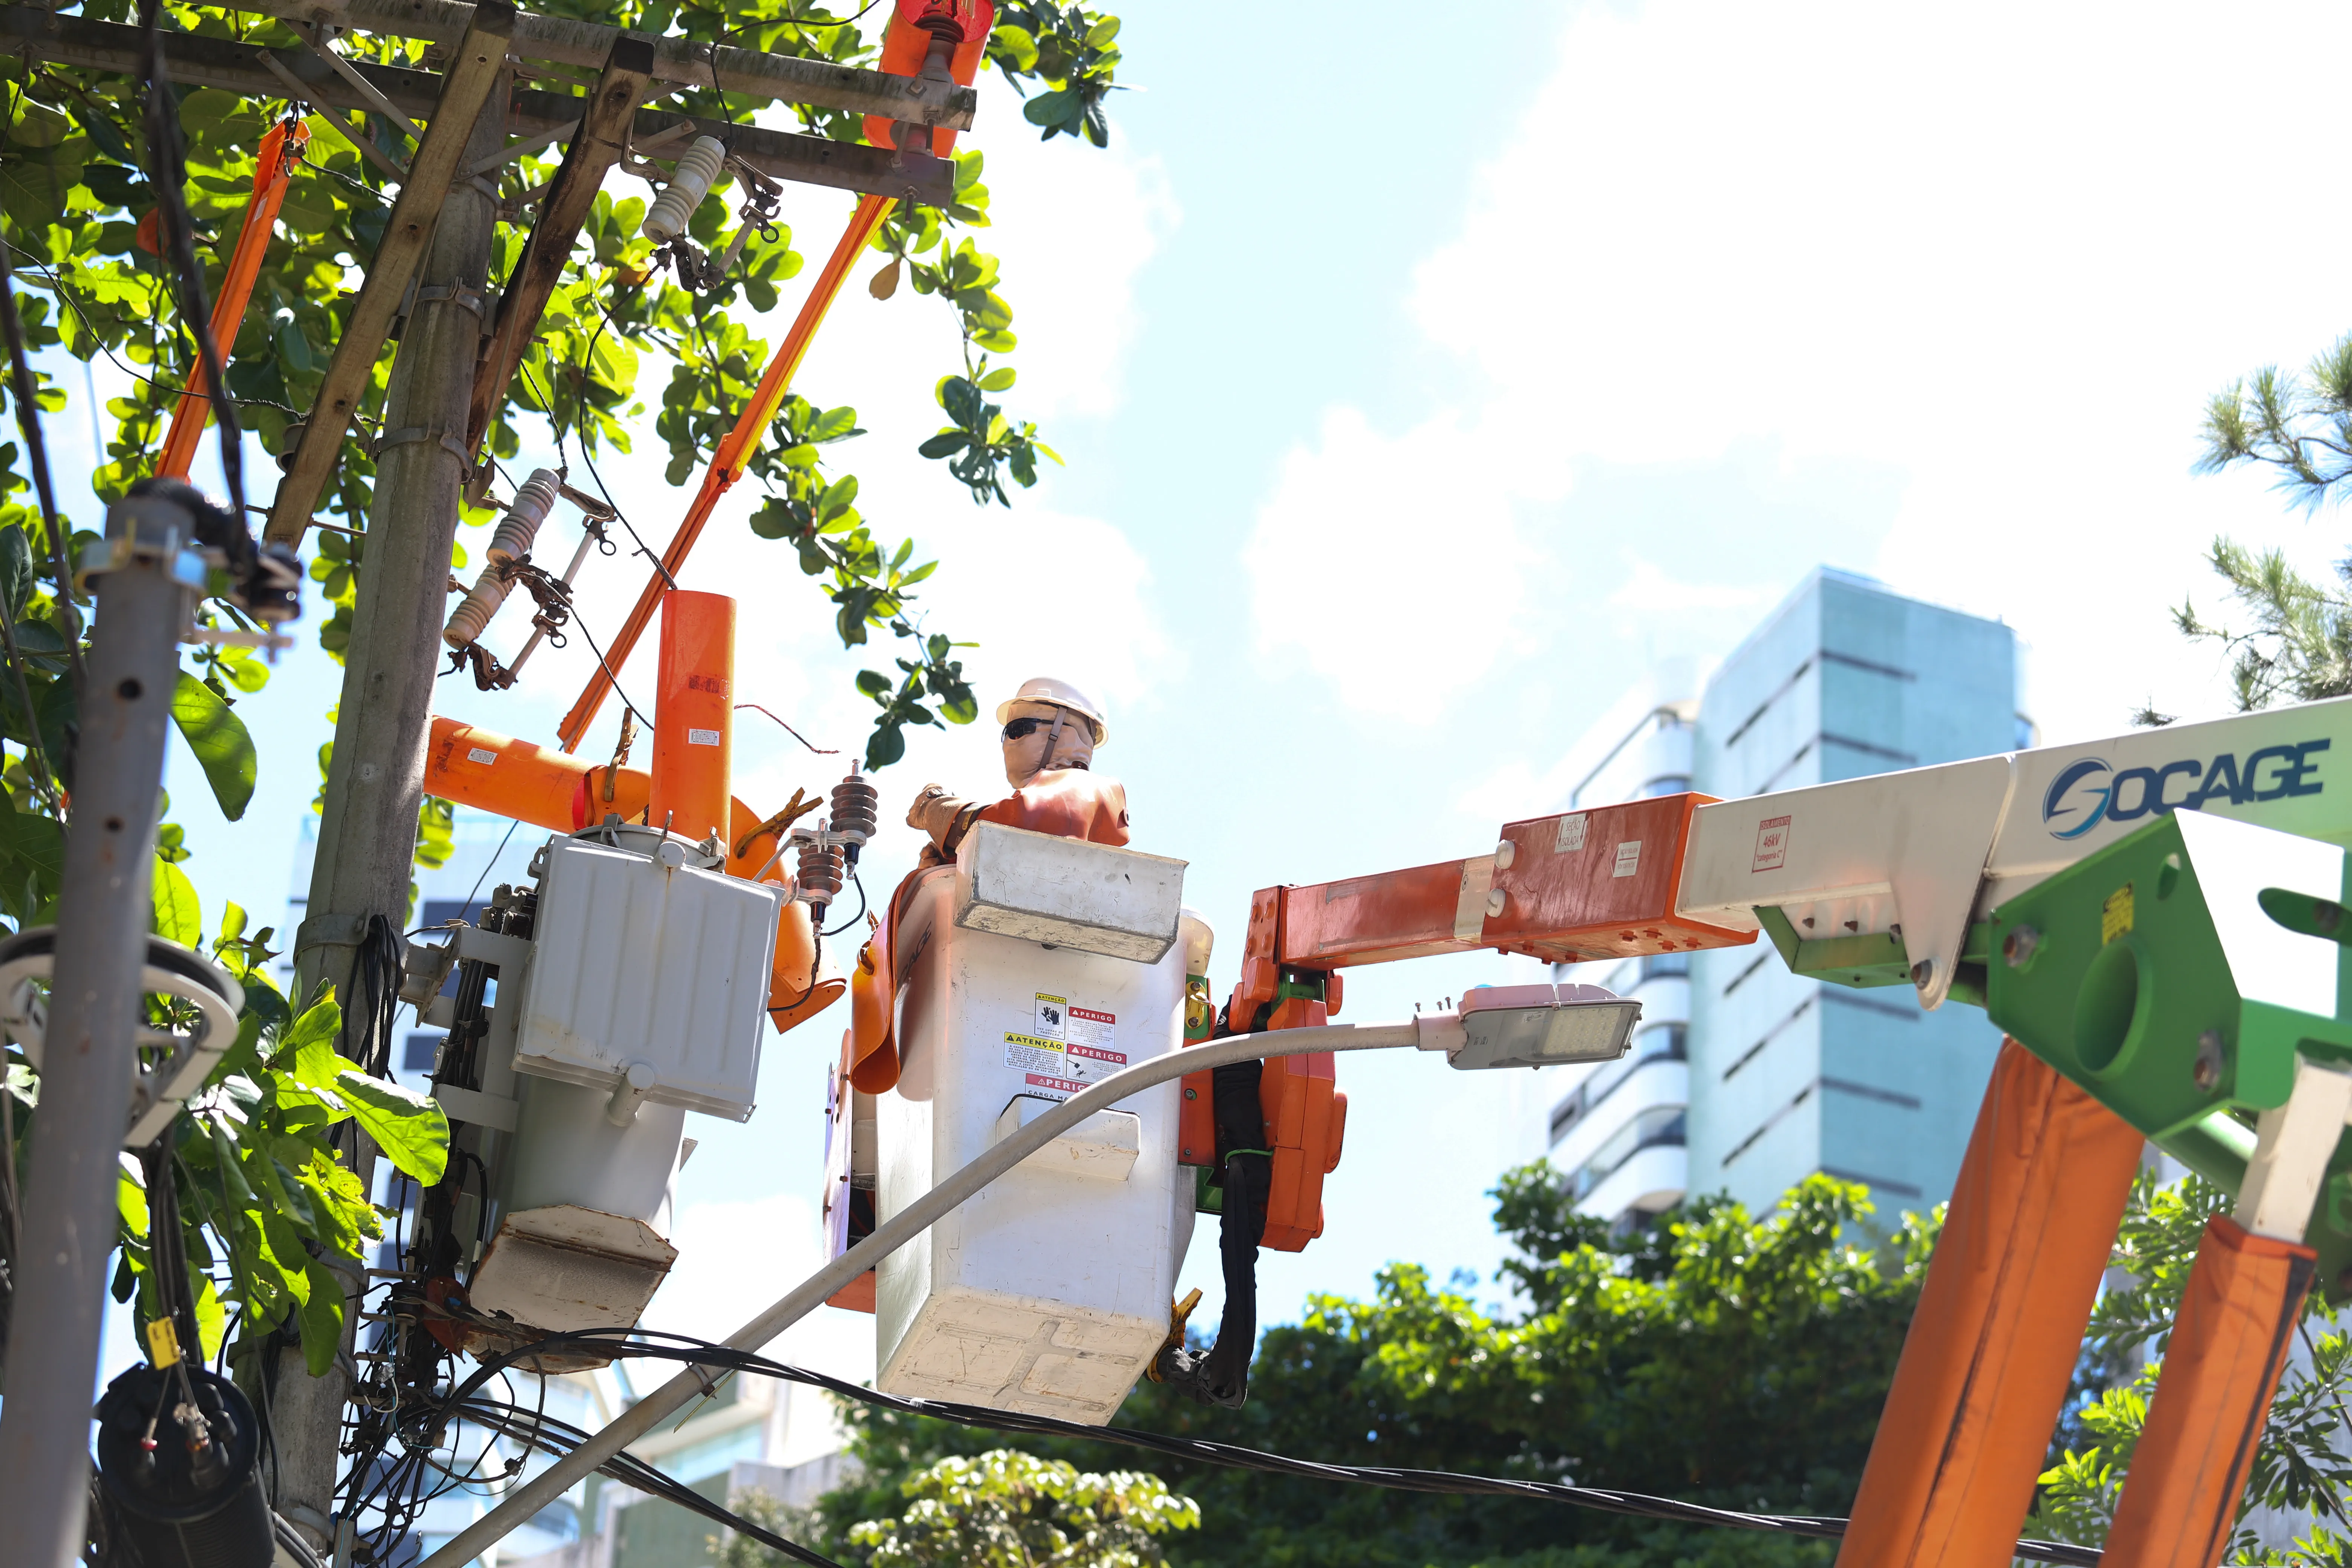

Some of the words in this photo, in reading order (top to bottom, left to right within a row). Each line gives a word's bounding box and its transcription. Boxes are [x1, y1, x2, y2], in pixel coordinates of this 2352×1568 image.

[2043, 738, 2331, 841] SOCAGE
[1566, 819, 1580, 833] SEÇÃO
[1760, 817, 1790, 829] ISOLAMENTO
[1562, 835, 1579, 847] ISOLADA
[1763, 833, 1781, 848] 46kV
[1080, 1011, 1112, 1021] PERIGO
[1016, 1037, 1062, 1049] ATENÇÃO
[1082, 1049, 1122, 1061] PERIGO
[1046, 1079, 1085, 1092] PERIG
[1029, 1090, 1054, 1099] CARGA
